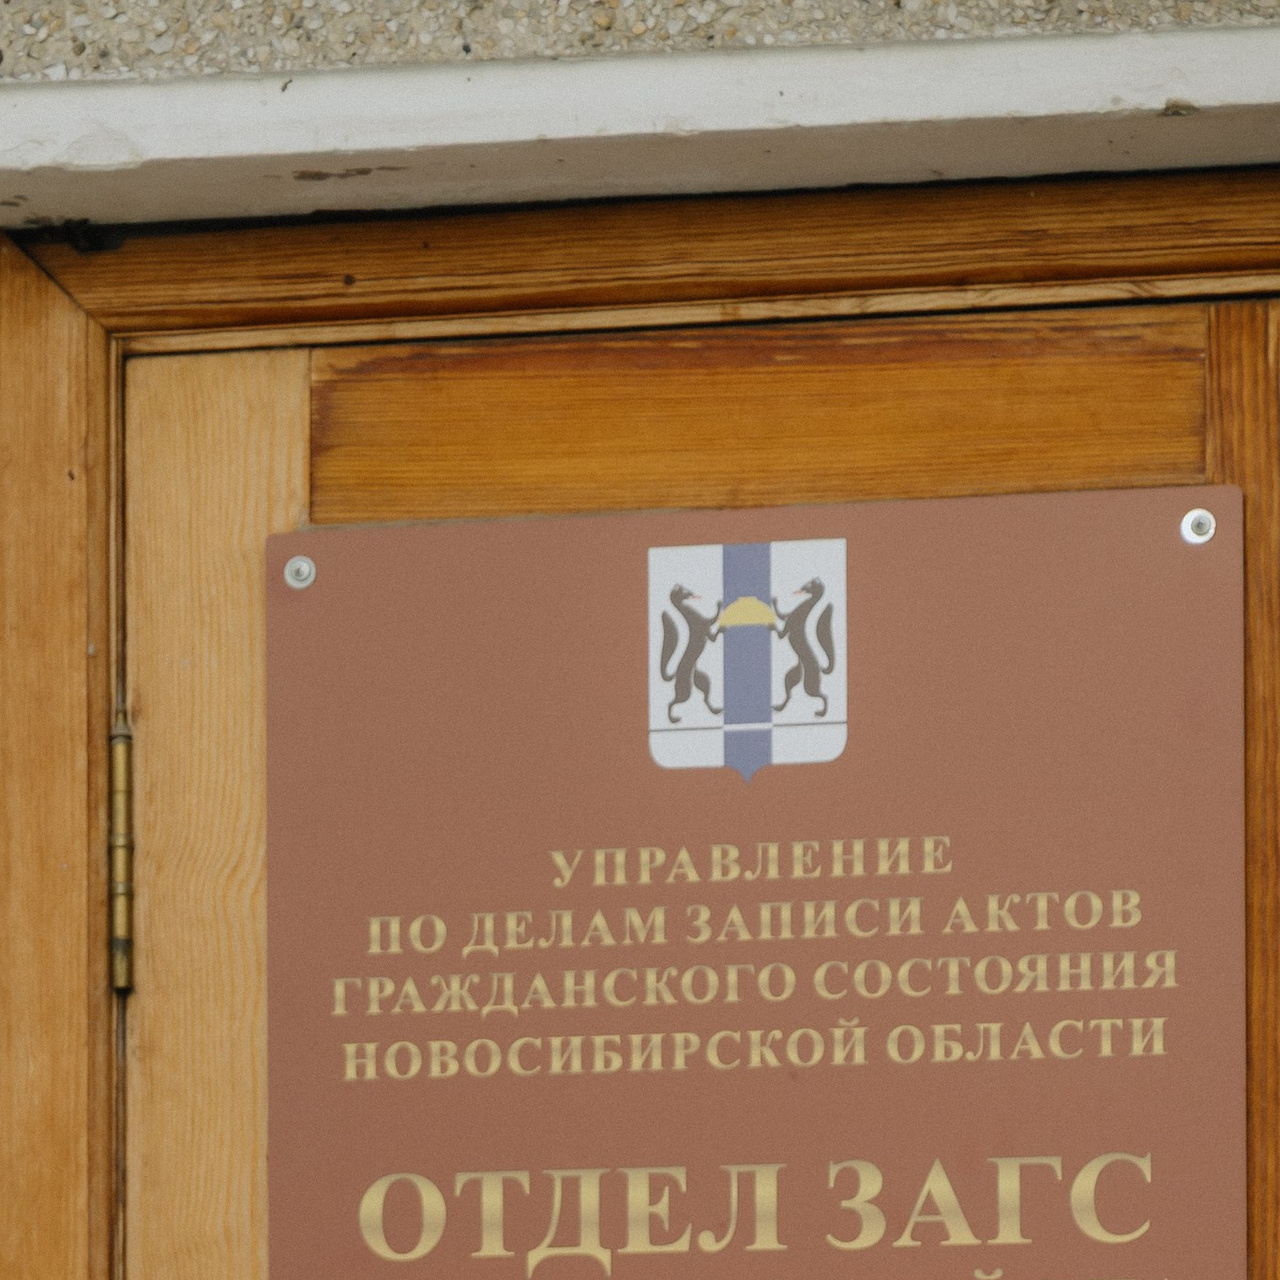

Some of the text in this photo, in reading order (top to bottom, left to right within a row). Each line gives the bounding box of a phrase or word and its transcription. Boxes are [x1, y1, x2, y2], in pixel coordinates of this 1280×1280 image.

[551, 836, 952, 887] УПРАВЛЕНИЕ
[368, 890, 1141, 957] ПО ДЕЛАМ ЗАПИСИ АКТОВ
[333, 950, 1177, 1017] ГРАЖДАНСКОГО СОСТОЯНИЯ
[344, 1018, 1166, 1081] НОВОСИБИРСКОЙ ОБЛАСТИ
[358, 1153, 1151, 1278] ОТДЕЛ ЗАГС
